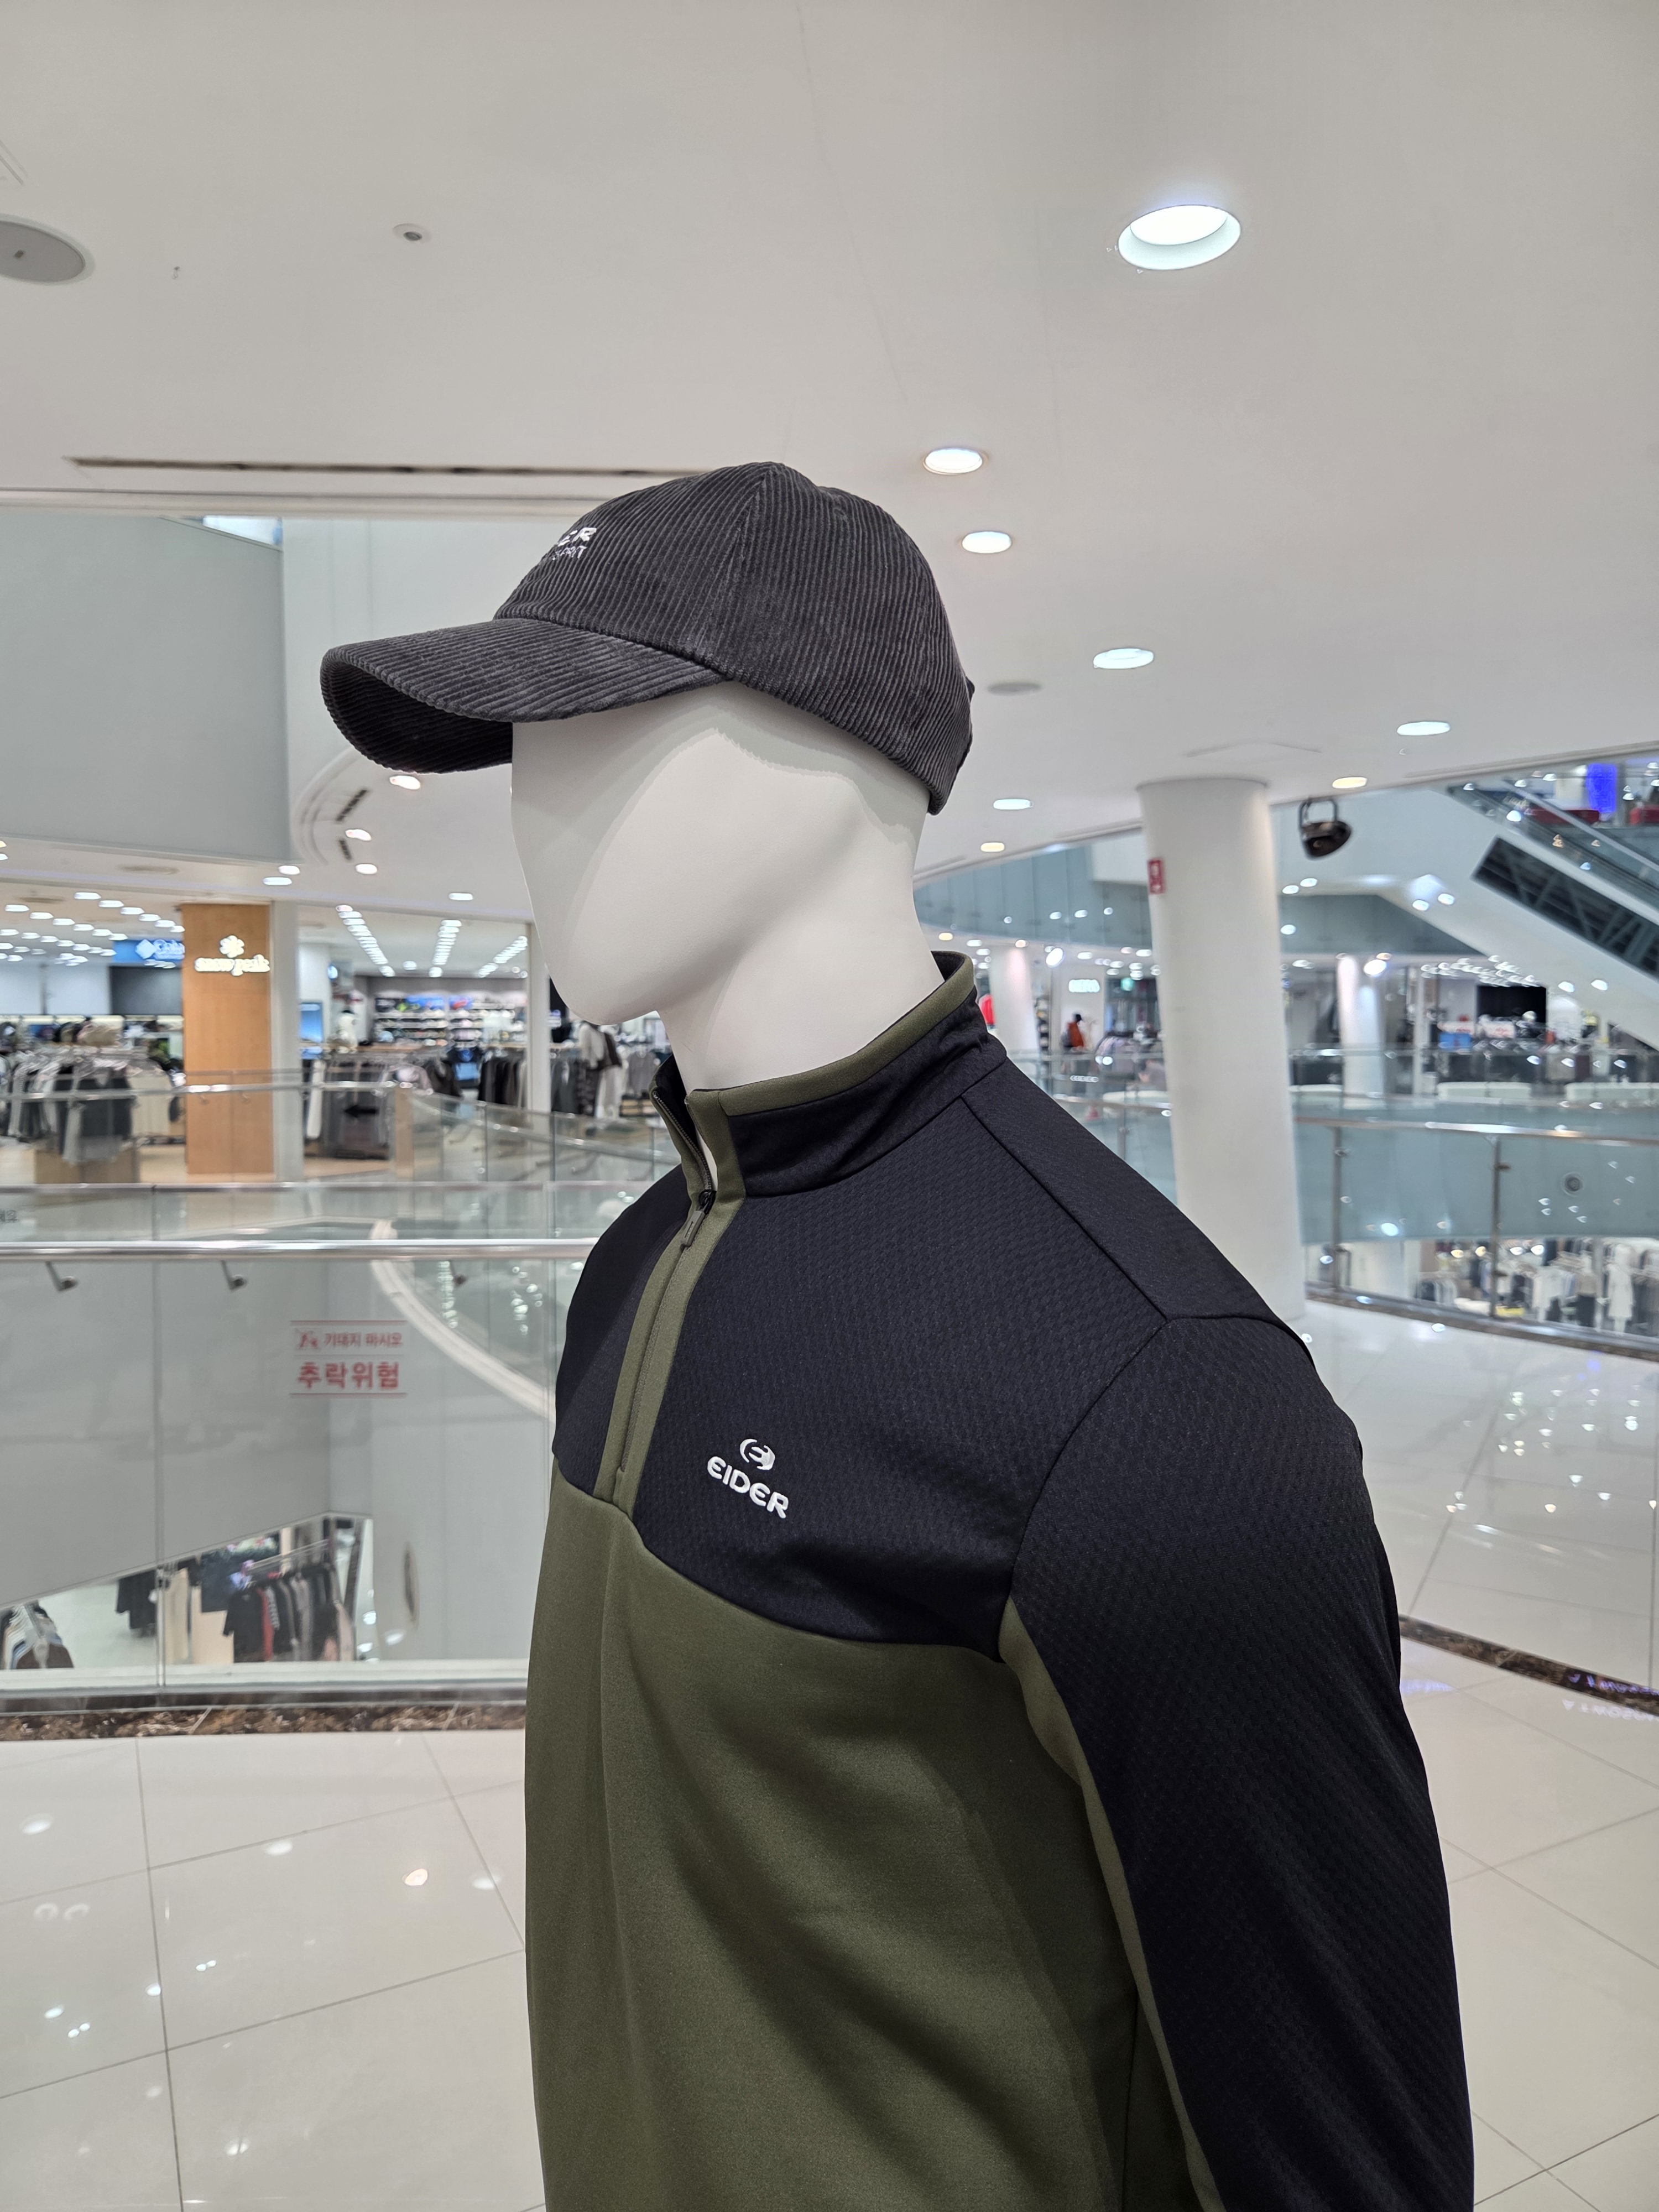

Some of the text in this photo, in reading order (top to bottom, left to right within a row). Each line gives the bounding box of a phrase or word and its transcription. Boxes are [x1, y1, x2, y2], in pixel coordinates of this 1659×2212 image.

[557, 527, 597, 546] ER
[366, 1332, 403, 1347] 마시오
[298, 1361, 399, 1390] 추락위험
[707, 1455, 789, 1519] EIDER
